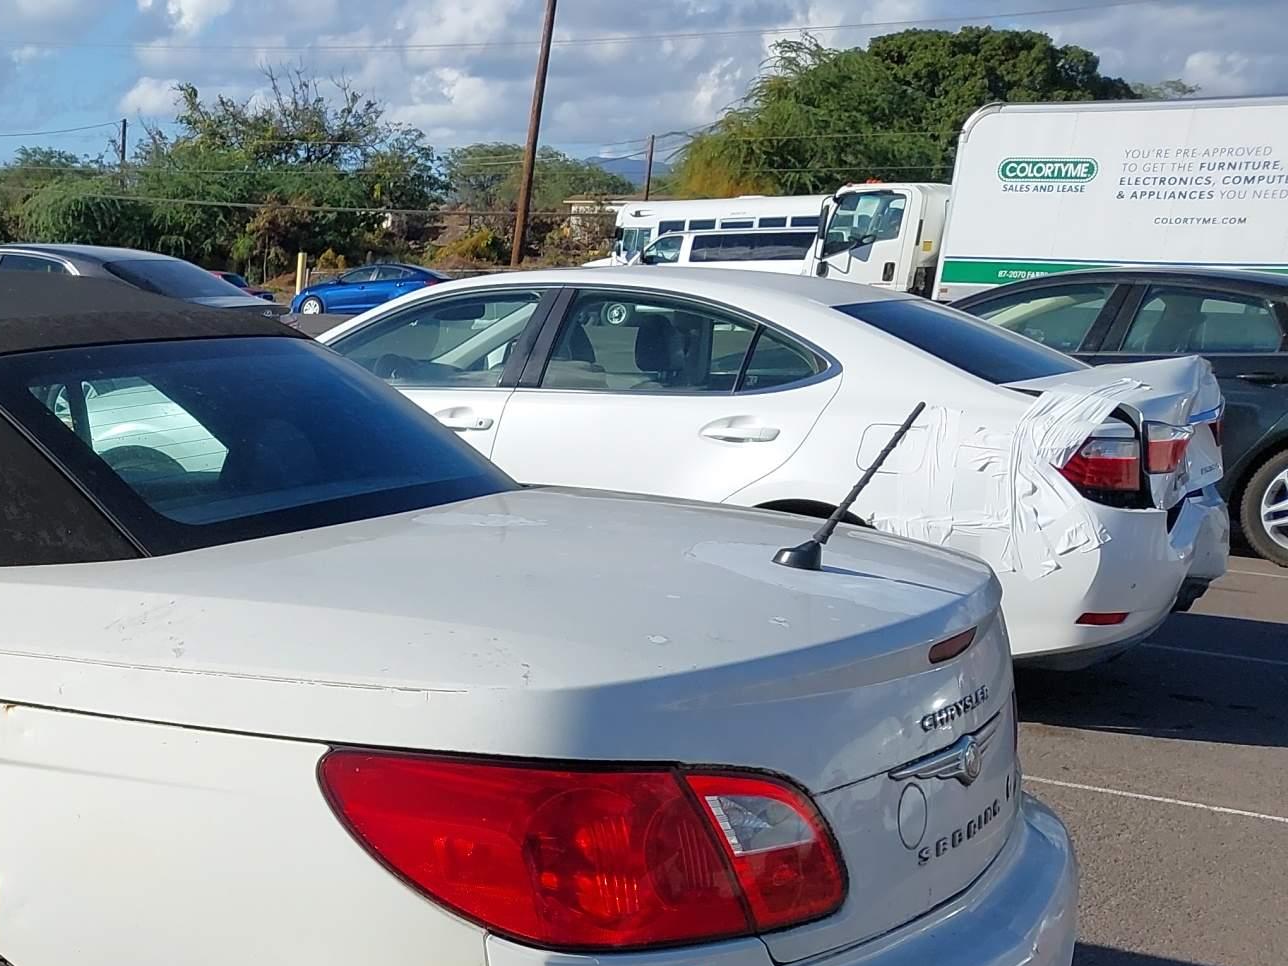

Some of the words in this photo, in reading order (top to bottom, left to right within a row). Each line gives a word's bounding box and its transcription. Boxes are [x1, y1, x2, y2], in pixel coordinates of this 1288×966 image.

[1124, 148, 1170, 159] YOU'RE
[1175, 146, 1273, 158] PRE-APPROVED
[1006, 162, 1090, 177] COLORTYME
[1122, 162, 1138, 172] TO
[1142, 162, 1167, 173] GET
[1170, 162, 1194, 173] THE
[1199, 160, 1284, 171] FURNITURE,
[1119, 175, 1216, 186] ELECTRONICS,
[1002, 184, 1031, 192] SALES
[1032, 184, 1054, 192] AND
[1057, 184, 1086, 192] LEASE
[1116, 190, 1125, 200] &
[1130, 190, 1215, 200] APPLIANCES
[1219, 190, 1247, 200] YOU
[1153, 217, 1247, 225] COLORTYME.COM
[997, 270, 1026, 279] 87-2070
[919, 685, 989, 733] CHRYSLER
[917, 799, 1001, 866] SEBRING
